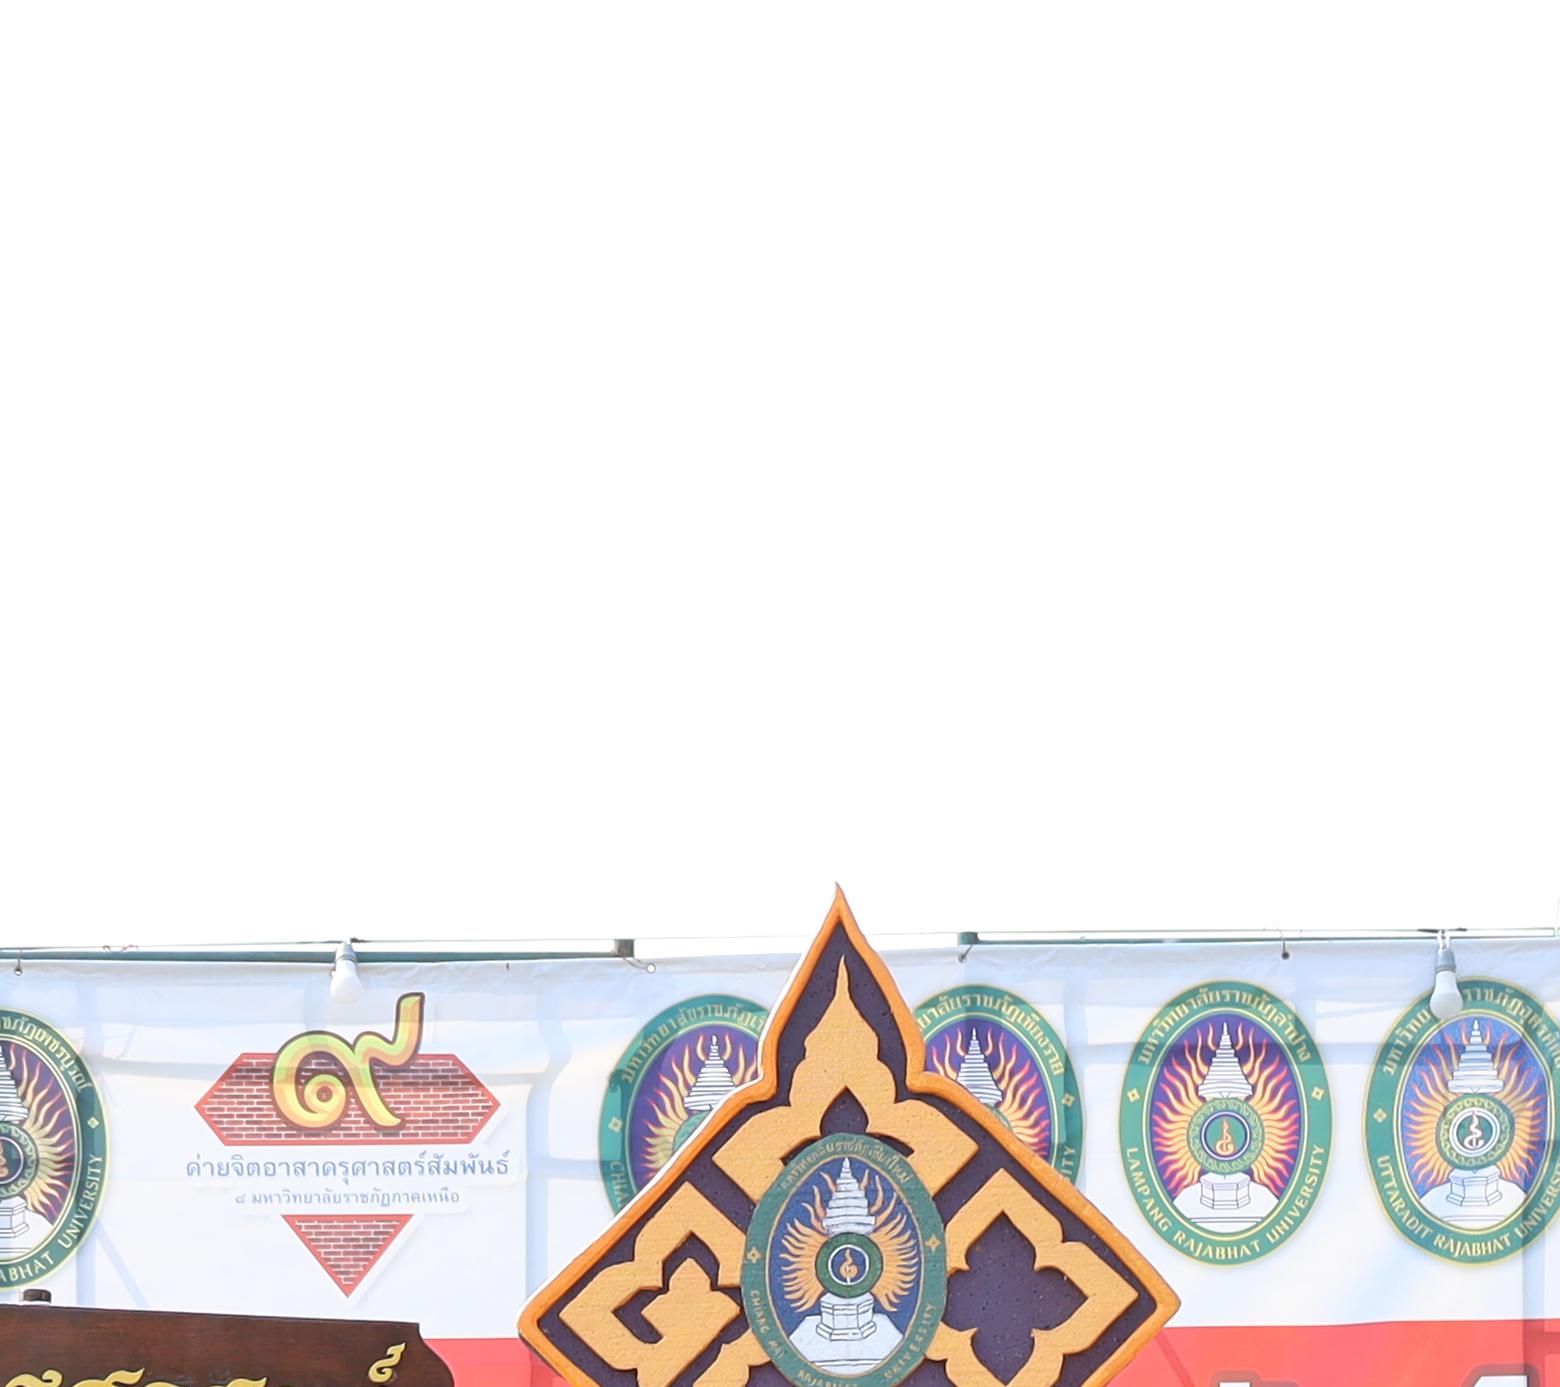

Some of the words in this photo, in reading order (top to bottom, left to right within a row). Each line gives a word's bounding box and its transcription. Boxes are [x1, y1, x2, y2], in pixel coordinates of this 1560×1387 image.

[271, 992, 425, 1131] ๙
[58, 1153, 103, 1249] UNIVERSITY
[186, 1150, 510, 1184] ค่ายจิตอาสาครุศาสตร์สัมพันธ์
[251, 1187, 459, 1206] มหาวิทยาลัยราชภัฏภาคเหนือ
[1126, 1146, 1173, 1233] LAMPANG
[1173, 1231, 1262, 1260] RAJABHAT
[1266, 1143, 1326, 1243] UNIVERSITY
[1377, 1155, 1434, 1240] UTTARADIT
[1433, 1233, 1514, 1258] RAJABHAT
[749, 1290, 770, 1334] CHIANG
[883, 1302, 936, 1380] UNIVERSITY
